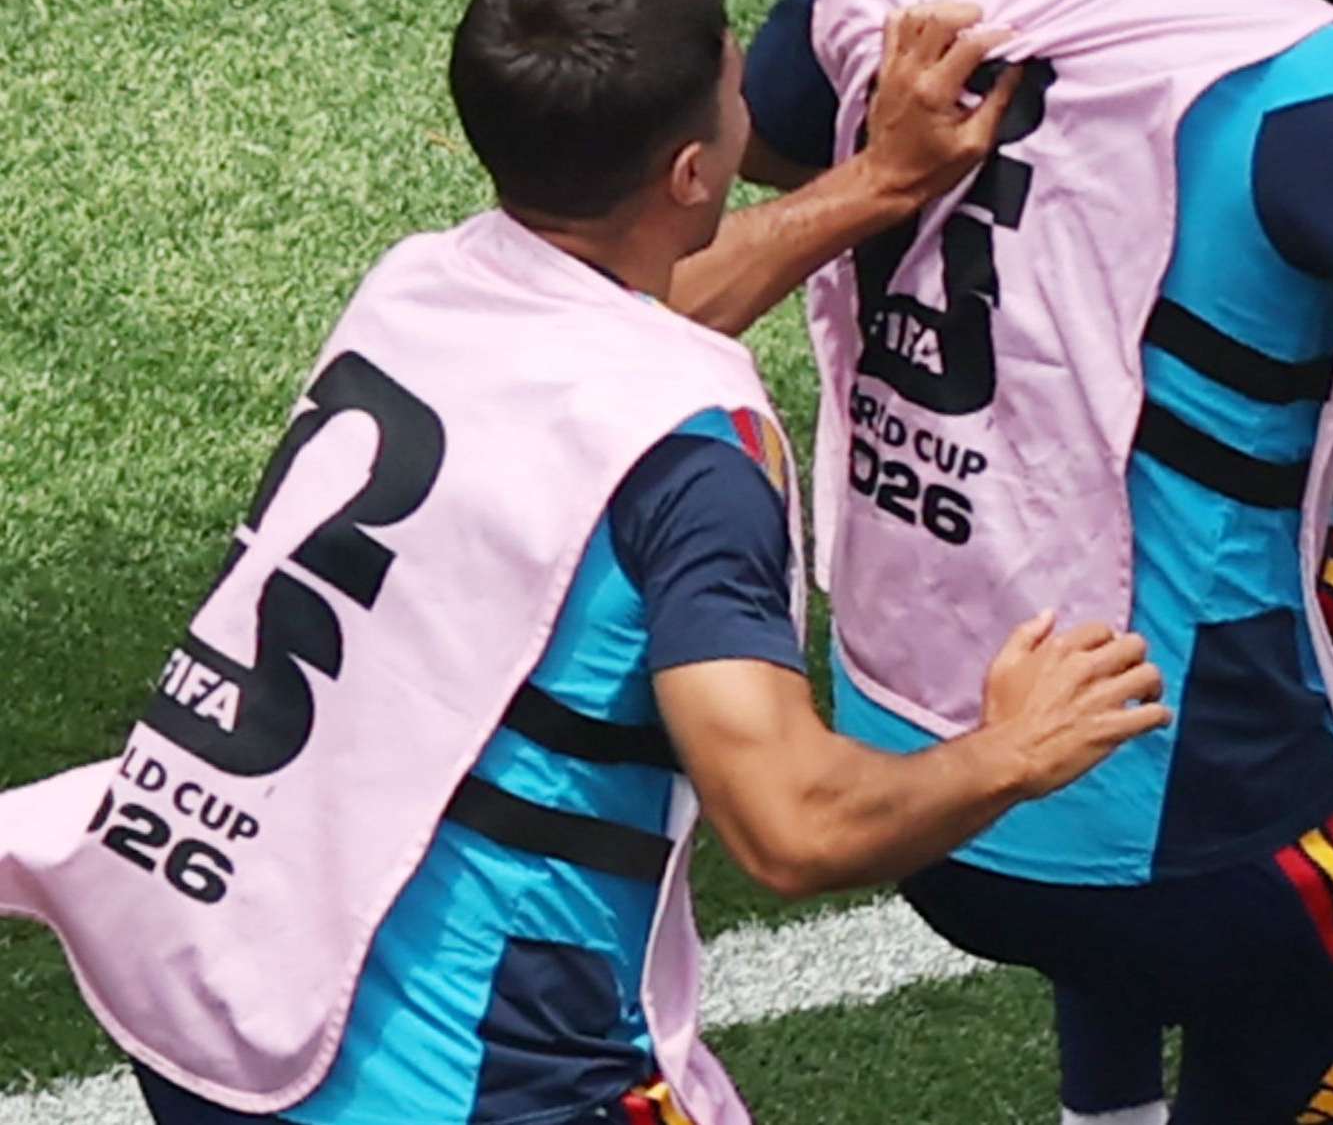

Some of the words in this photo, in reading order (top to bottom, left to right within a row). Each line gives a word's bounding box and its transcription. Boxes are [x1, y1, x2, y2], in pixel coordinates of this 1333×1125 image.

[868, 309, 945, 375] IFA
[913, 428, 988, 480] CUP
[172, 781, 259, 841] CUP
